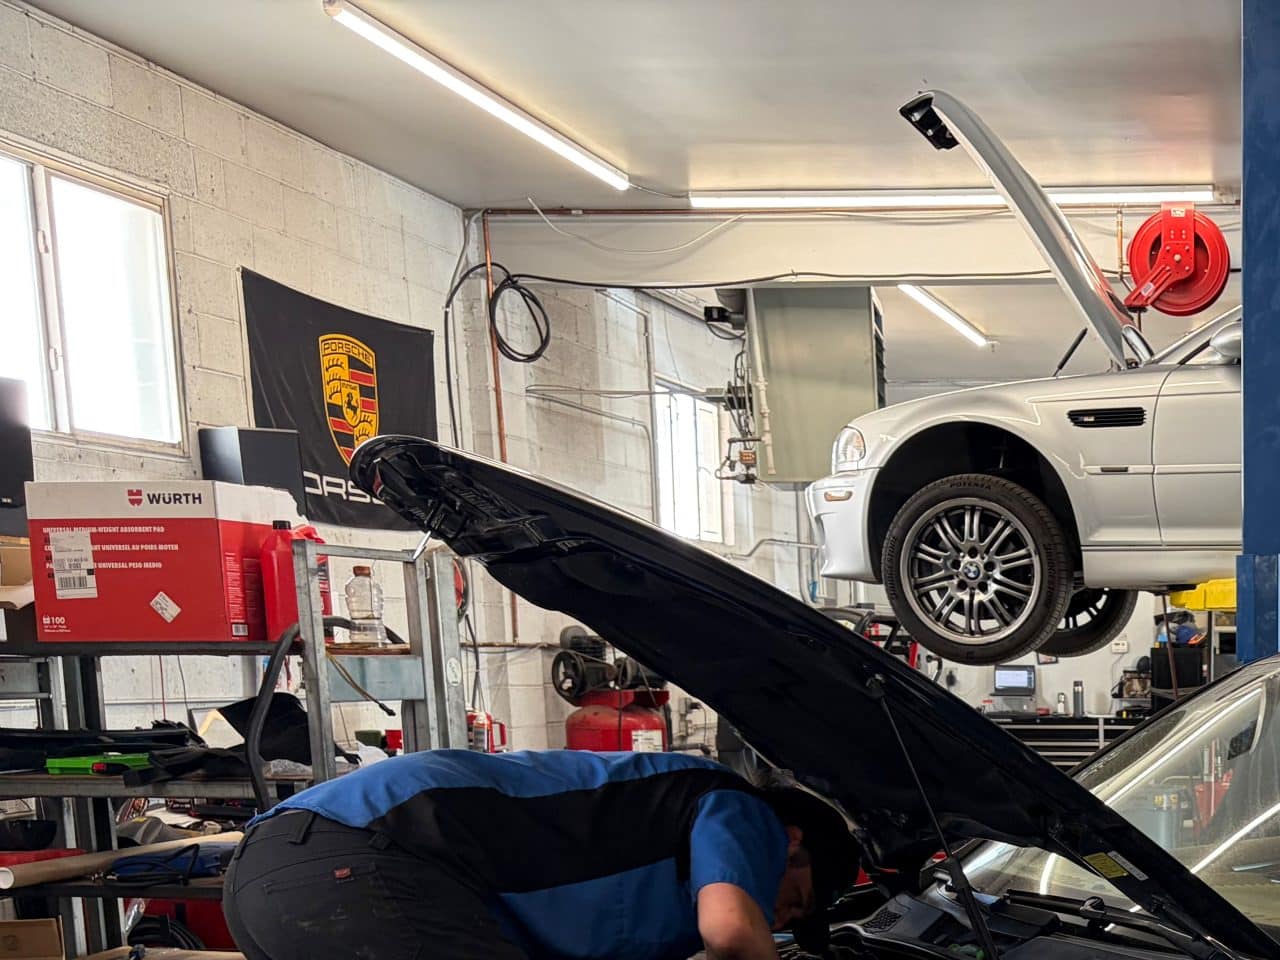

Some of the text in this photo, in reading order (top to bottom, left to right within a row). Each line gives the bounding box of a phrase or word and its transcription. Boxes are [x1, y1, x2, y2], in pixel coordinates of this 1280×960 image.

[322, 341, 372, 365] PORSCHE
[146, 492, 203, 505] WÜRTH
[119, 526, 152, 534] ABSORBENT
[97, 561, 127, 569] UNIVERSAL
[51, 616, 66, 625] 100
